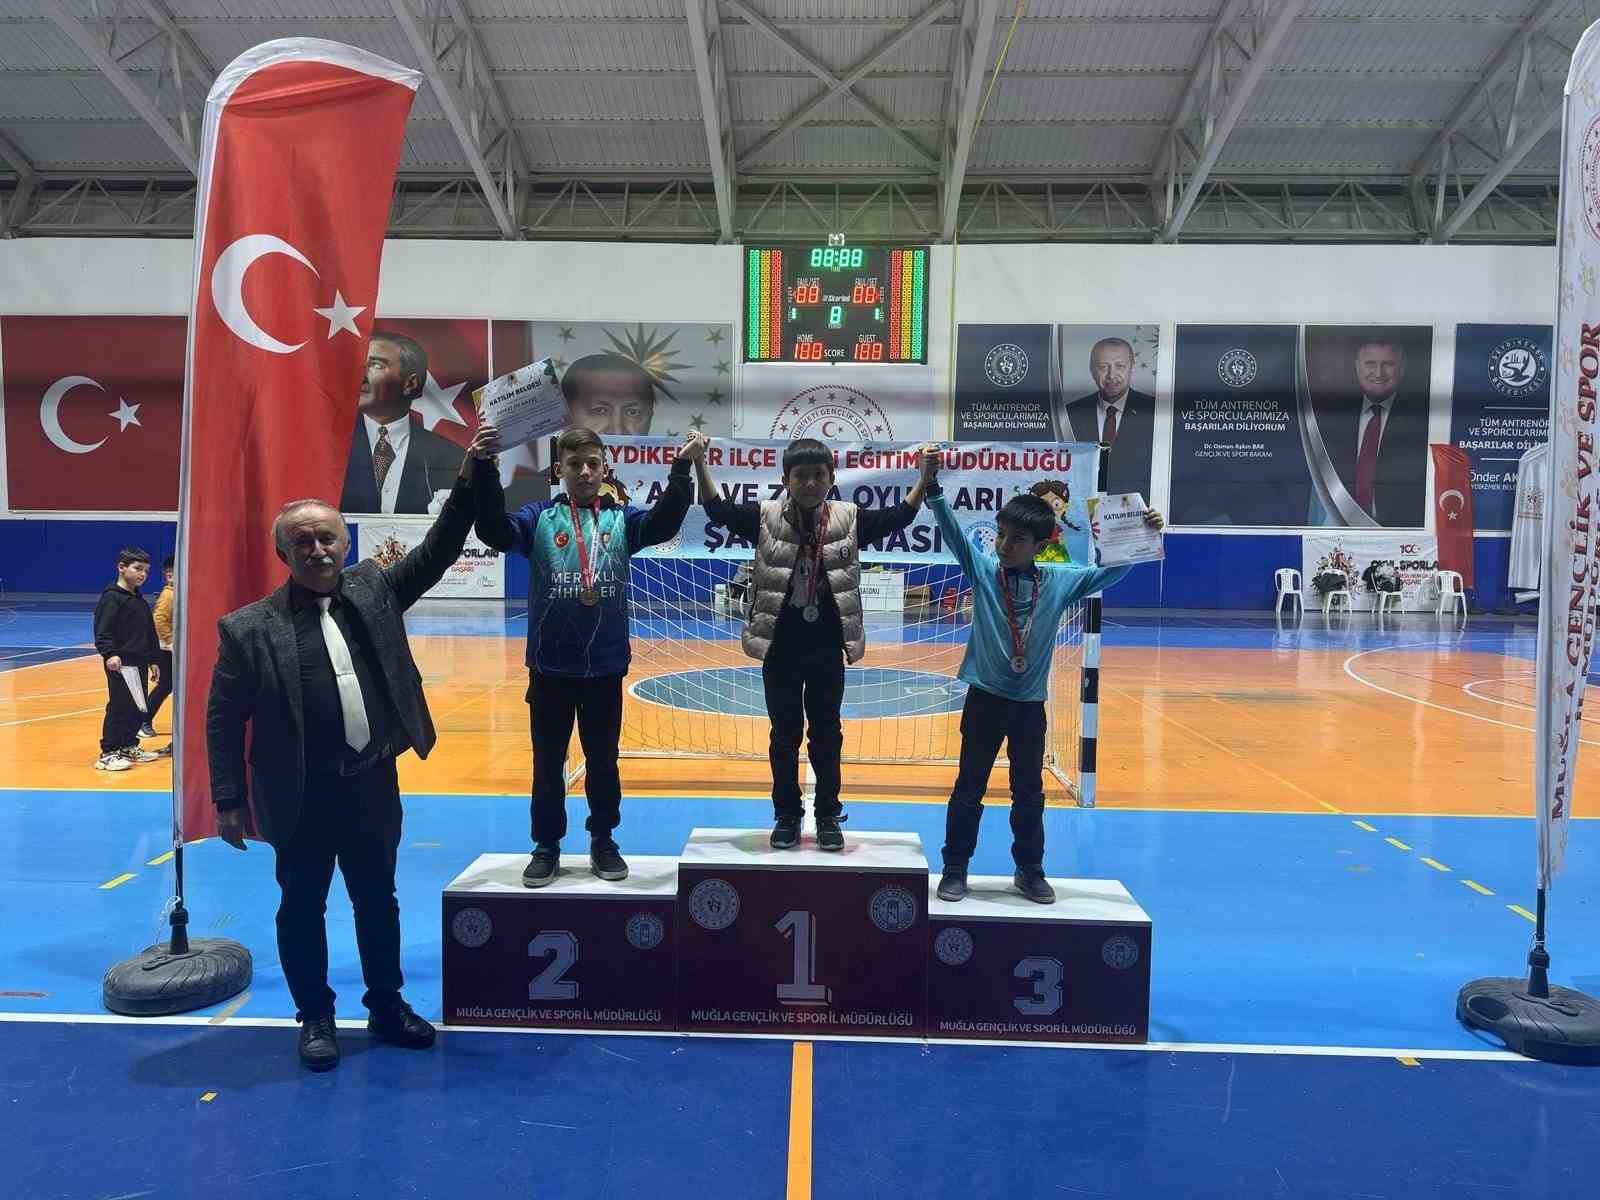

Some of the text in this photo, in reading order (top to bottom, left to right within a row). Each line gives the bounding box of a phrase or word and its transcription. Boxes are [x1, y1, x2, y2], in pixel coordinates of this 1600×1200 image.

[823, 349, 845, 357] SCORE
[1577, 322, 1600, 424] SPOR
[488, 391, 515, 408] KATILIM
[1194, 399, 1279, 411] TÜM ANTRENÖR
[960, 411, 972, 420] VE
[1181, 410, 1195, 421] VE
[1479, 417, 1500, 427] TÜM
[1184, 423, 1234, 432] BAŞARILAR
[1468, 427, 1548, 437] VE SPORCULARIM
[1459, 440, 1514, 451] BAŞARILAR
[729, 447, 777, 470] İLÇE
[846, 446, 920, 470] EĞİTİM
[938, 448, 1072, 471] ÜDÜRLÜĞÜ
[1577, 431, 1594, 480] VE
[551, 571, 615, 584] MERKLI
[1566, 488, 1591, 667] GENÇLİK
[528, 929, 580, 1001] 2
[774, 910, 833, 1006] 1
[1013, 955, 1065, 1016] 3
[456, 1006, 662, 1022] MUĞLA GENÇLİK VE SPOR İL MÜDÜRLÜĞÜ
[691, 1008, 913, 1026] MUĞLA GENÇLİK VE SPOR İL MÜDÜRLÜĞÜ
[940, 1020, 1136, 1035] MUĞLA GENÇLİK VE SPOR İL MÜDÜRLÜĞÜ
